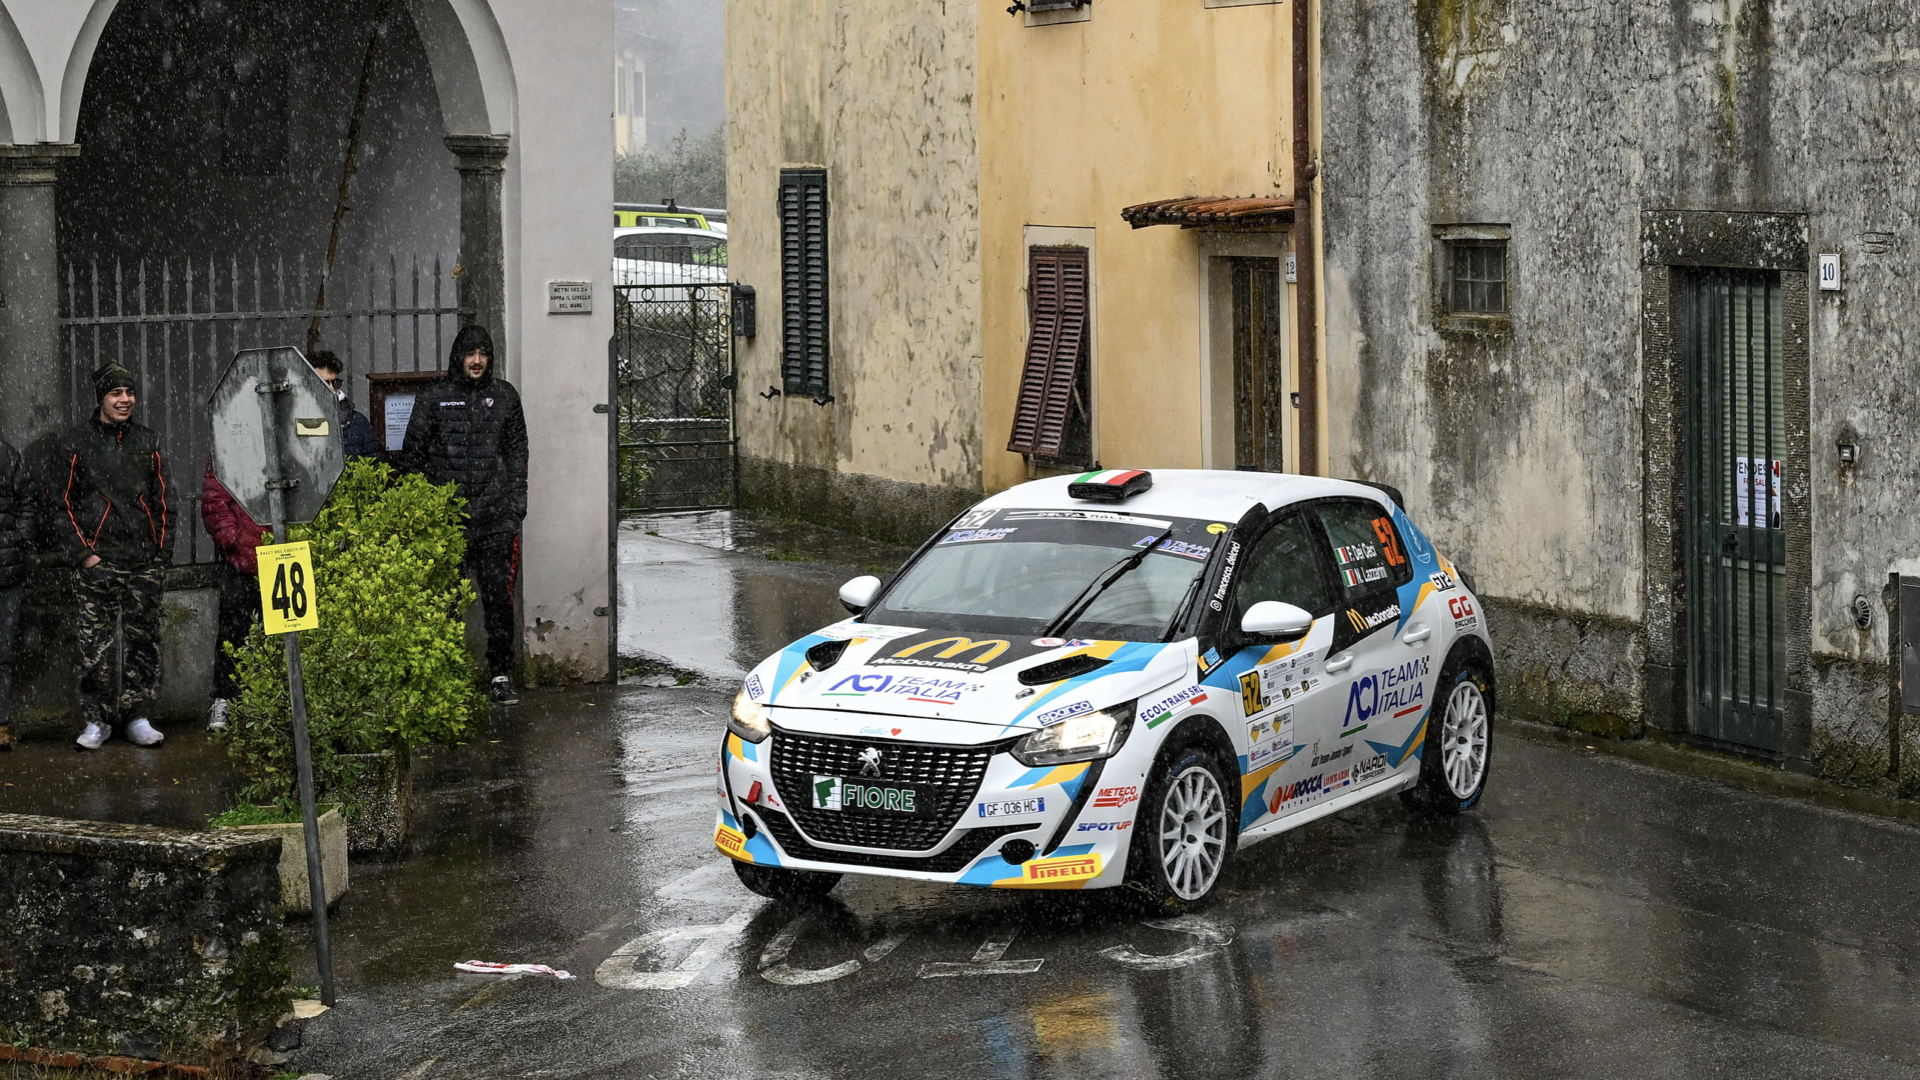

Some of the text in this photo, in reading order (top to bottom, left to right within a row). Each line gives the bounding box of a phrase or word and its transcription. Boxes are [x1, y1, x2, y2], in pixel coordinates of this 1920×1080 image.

[1285, 261, 1295, 275] 12
[1822, 262, 1835, 281] 10
[953, 509, 997, 529] 52
[1037, 511, 1136, 522] DELTA RALLY
[939, 530, 977, 544] ACI
[1173, 540, 1211, 552] TEAM
[1371, 517, 1406, 567] 52
[1352, 543, 1365, 561] Dei
[1362, 541, 1378, 559] Ceci
[1354, 562, 1388, 585] N. Lazzarini
[271, 561, 308, 620] 48
[1365, 604, 1402, 628] McDonald's
[1448, 595, 1474, 620] GG
[1454, 616, 1477, 629] MACCHINE
[870, 657, 989, 673] McDonald's
[828, 674, 967, 693] ACI TEAM
[884, 684, 963, 701] ITALIA
[1343, 674, 1379, 728] ACI
[1381, 658, 1419, 691] TEAM
[1139, 684, 1205, 723] ECOLTRANS SRL
[1240, 672, 1263, 716] 52
[1377, 681, 1423, 715] ITALIA
[1039, 701, 1092, 725] sparco
[859, 725, 888, 737] Giulio
[1319, 753, 1330, 765] Team
[1341, 743, 1354, 758] Sport
[1359, 752, 1388, 774] NARDI
[1360, 767, 1386, 782] COMPRESSORI
[1097, 785, 1137, 797] METECO
[1282, 772, 1324, 802] LAROCCA
[843, 784, 916, 812] FIORE
[986, 803, 998, 816] GF
[1003, 801, 1022, 815] 036
[1023, 799, 1037, 813] HC
[1117, 793, 1139, 808] Corse
[1280, 793, 1322, 811] PETROLI
[1076, 820, 1133, 832] SPOTUP
[715, 828, 743, 852] PIRELLI
[1029, 859, 1096, 880] PIRELLI
